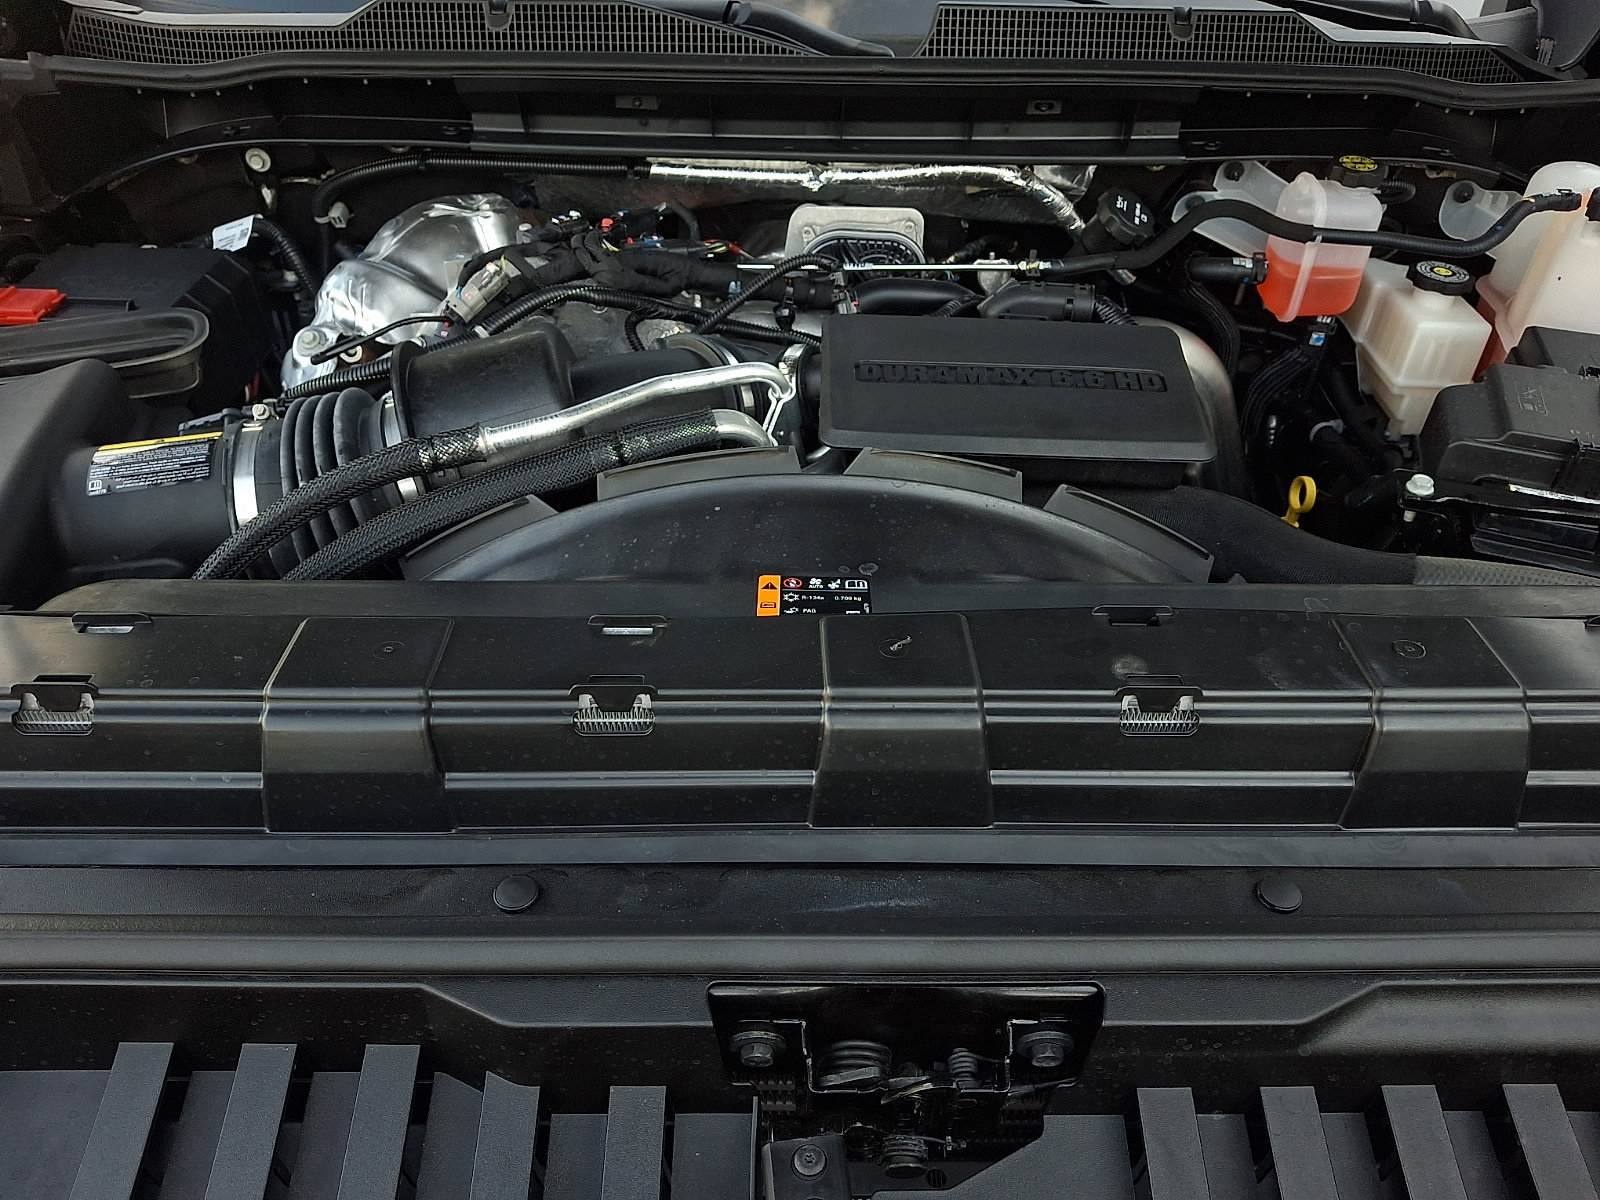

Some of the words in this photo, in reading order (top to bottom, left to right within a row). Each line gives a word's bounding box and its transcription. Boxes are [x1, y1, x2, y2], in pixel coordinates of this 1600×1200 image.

[859, 364, 1035, 385] DURAMAX
[1051, 369, 1105, 388] 6.6
[1115, 372, 1164, 391] HD
